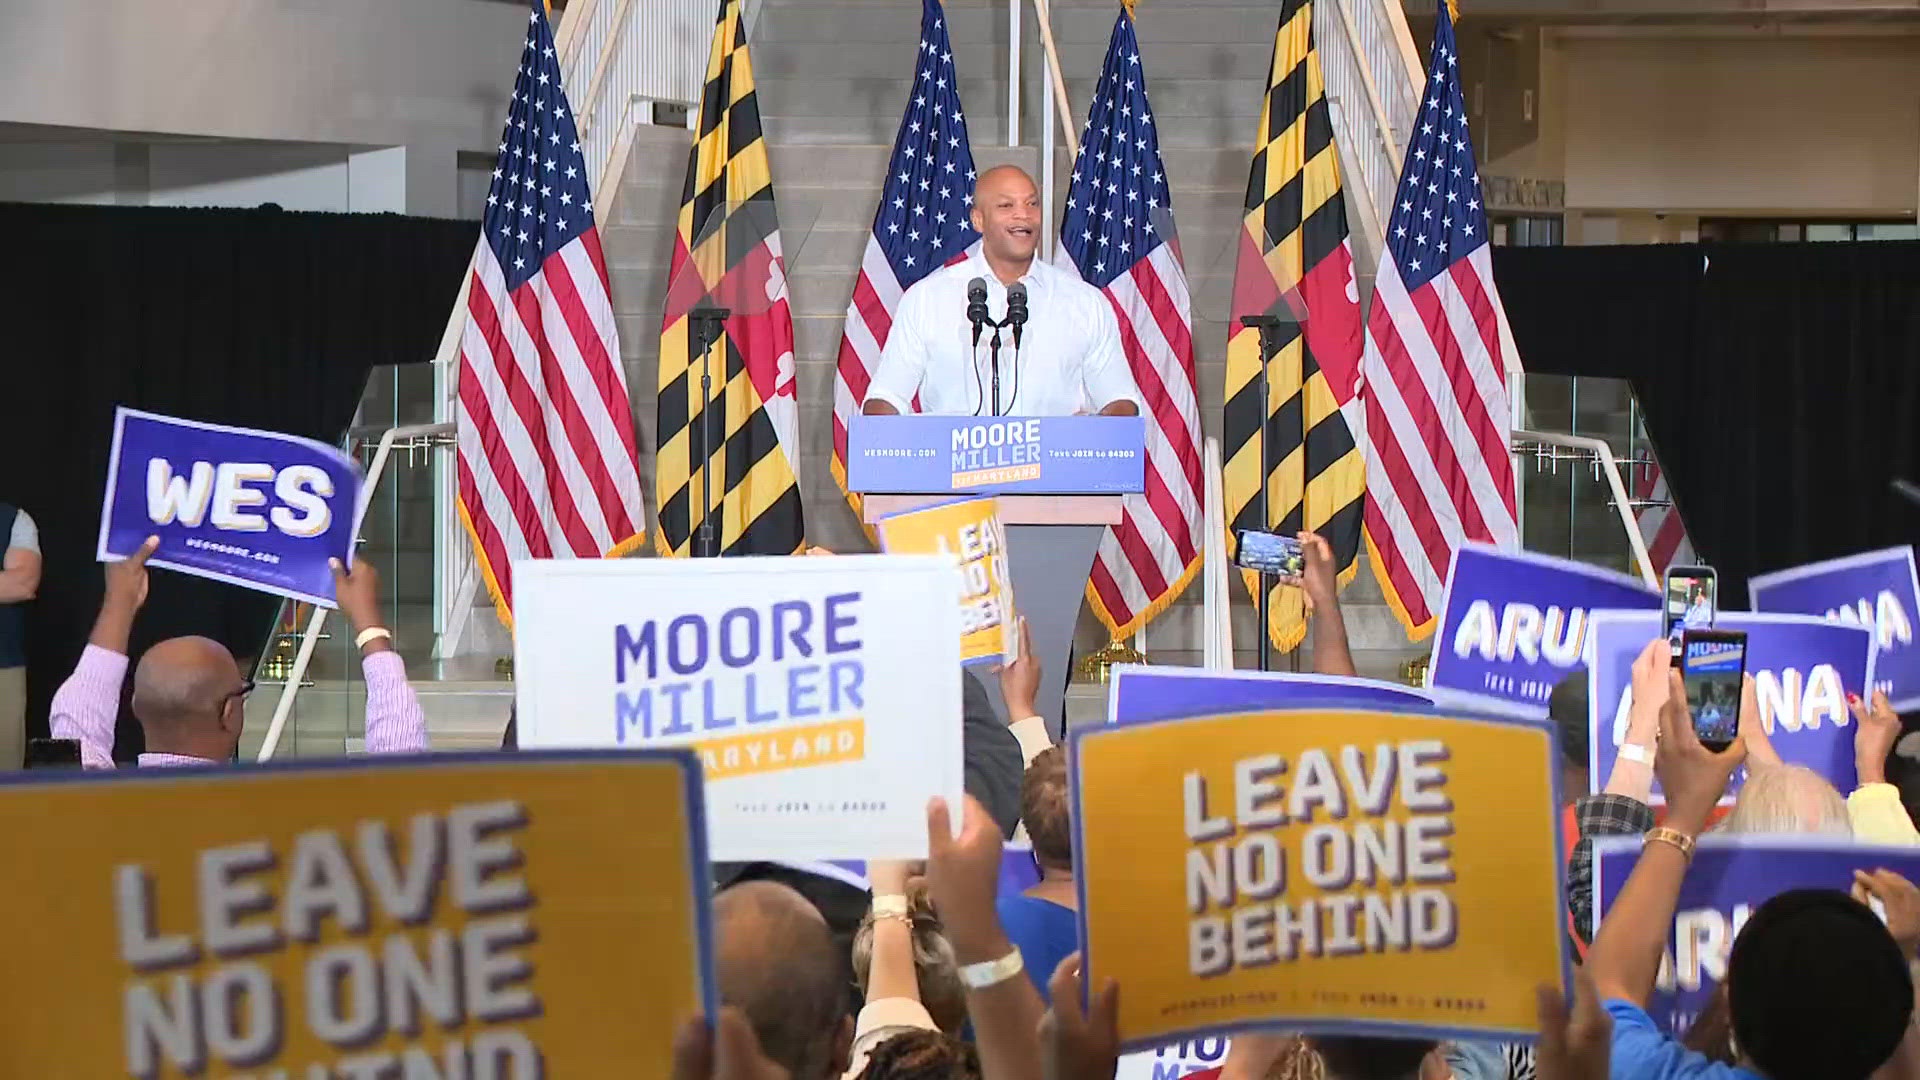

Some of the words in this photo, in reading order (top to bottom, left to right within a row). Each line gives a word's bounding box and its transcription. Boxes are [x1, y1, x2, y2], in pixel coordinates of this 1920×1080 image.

[864, 448, 937, 457] WESMOORE.COM
[952, 419, 1040, 451] MOORE
[952, 442, 1041, 472] MILLER
[973, 467, 1037, 482] MARYLAND
[146, 456, 334, 537] WES
[615, 592, 863, 684] MOORE
[1454, 599, 1590, 667] ARU
[616, 659, 864, 744] MILLER
[702, 729, 855, 772] ARYLAND
[1183, 739, 1454, 841] LEAVE
[114, 799, 536, 975] LEAVE
[1185, 832, 1285, 914] NO
[1303, 816, 1456, 890] ONE
[1188, 889, 1458, 978] BEHIND
[121, 961, 286, 1080] NO
[306, 913, 544, 1047] ONE
